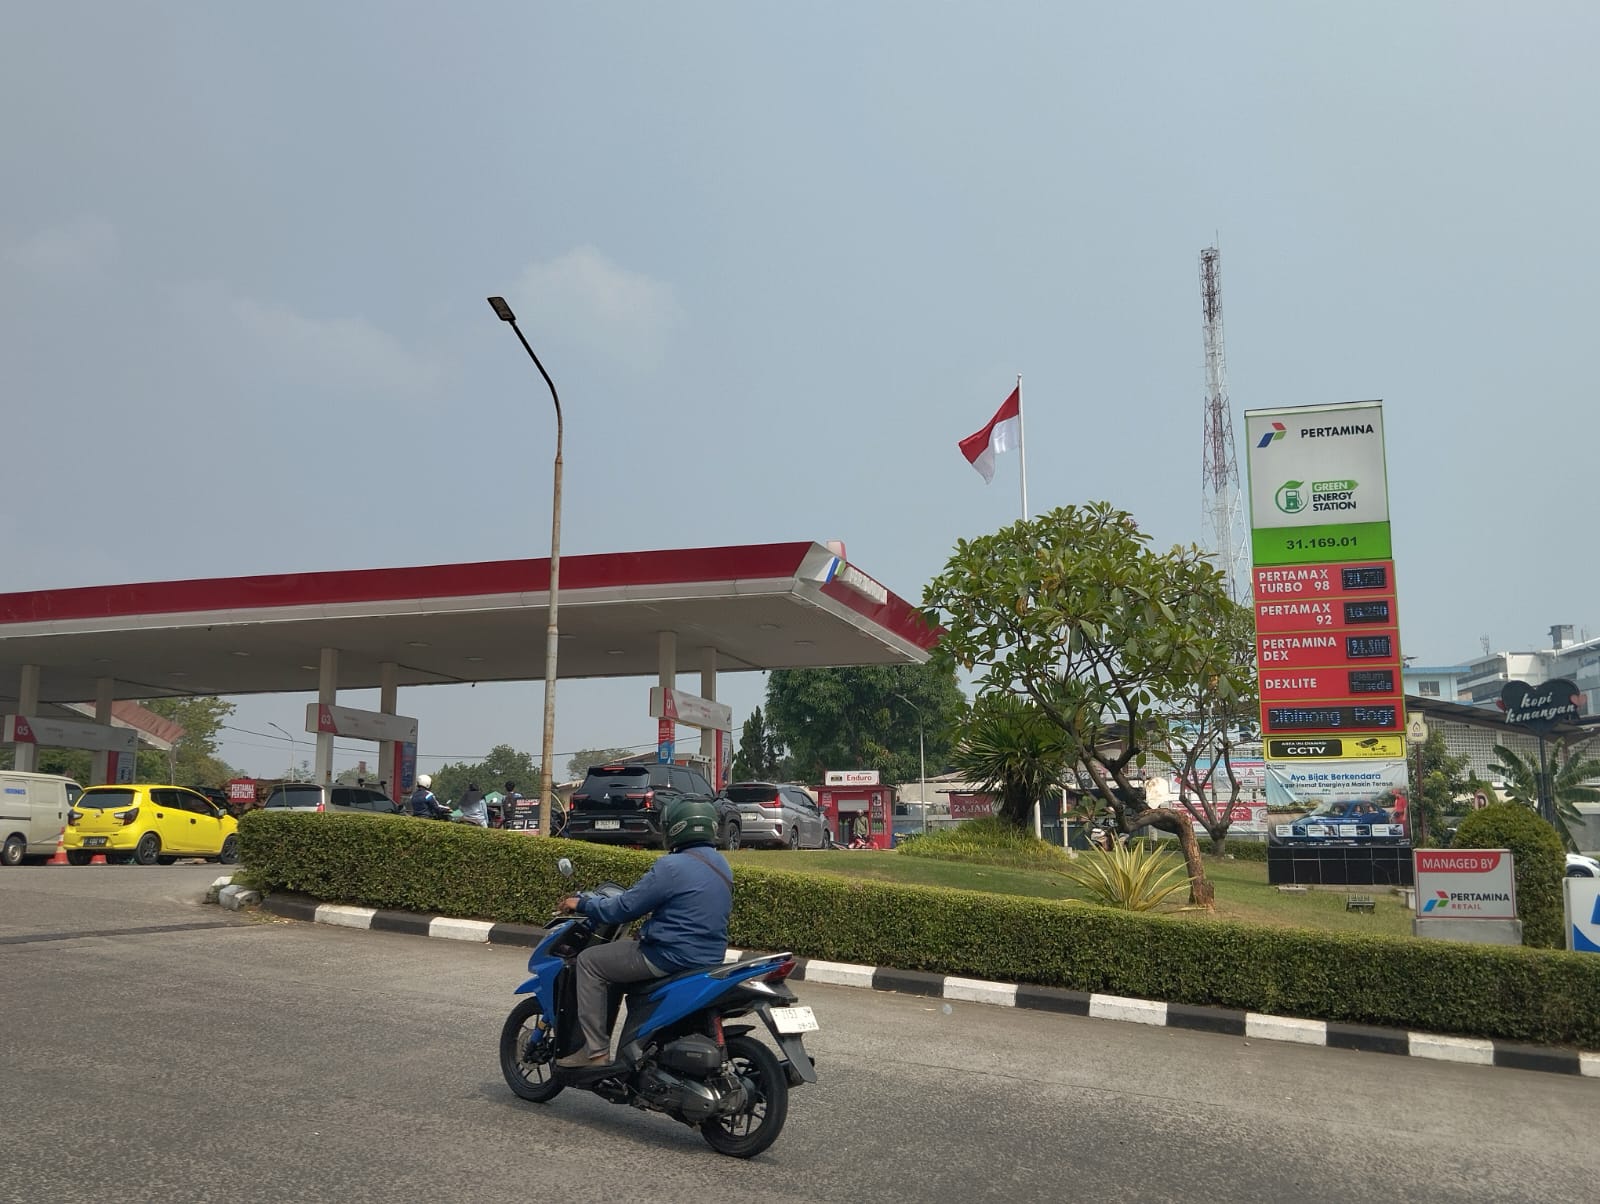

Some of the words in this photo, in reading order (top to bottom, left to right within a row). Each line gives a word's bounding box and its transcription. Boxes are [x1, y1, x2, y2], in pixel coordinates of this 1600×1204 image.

[1301, 424, 1374, 438] PERTAMINA
[1314, 481, 1348, 491] GREEN
[1312, 492, 1353, 502] ENERGY
[1313, 501, 1356, 511] STATION
[1286, 537, 1357, 550] 31.169.01
[1259, 569, 1328, 581] PERTAMAX
[1260, 582, 1303, 594] TURBO
[1314, 581, 1330, 591] 98
[1261, 603, 1330, 615] PERTAMAX
[1316, 615, 1332, 625] 92
[1262, 637, 1336, 649] PERTAMINA
[1263, 651, 1289, 661] DEX
[1265, 678, 1317, 689] DEXLITE
[666, 699, 673, 709] 01
[1520, 692, 1552, 708] kopi
[1505, 704, 1576, 723] kenangan
[321, 714, 331, 724] 03
[17, 726, 29, 735] 05
[1287, 746, 1326, 754] CCTV
[1290, 774, 1305, 782] Ayo
[1308, 773, 1328, 782] Bijak
[231, 784, 255, 792] PERTAMAX
[954, 804, 967, 812] 24
[968, 804, 990, 812] JAM
[1422, 858, 1478, 870] MANAGED
[1480, 858, 1494, 870] BY
[1450, 891, 1511, 902] PERTAMINA
